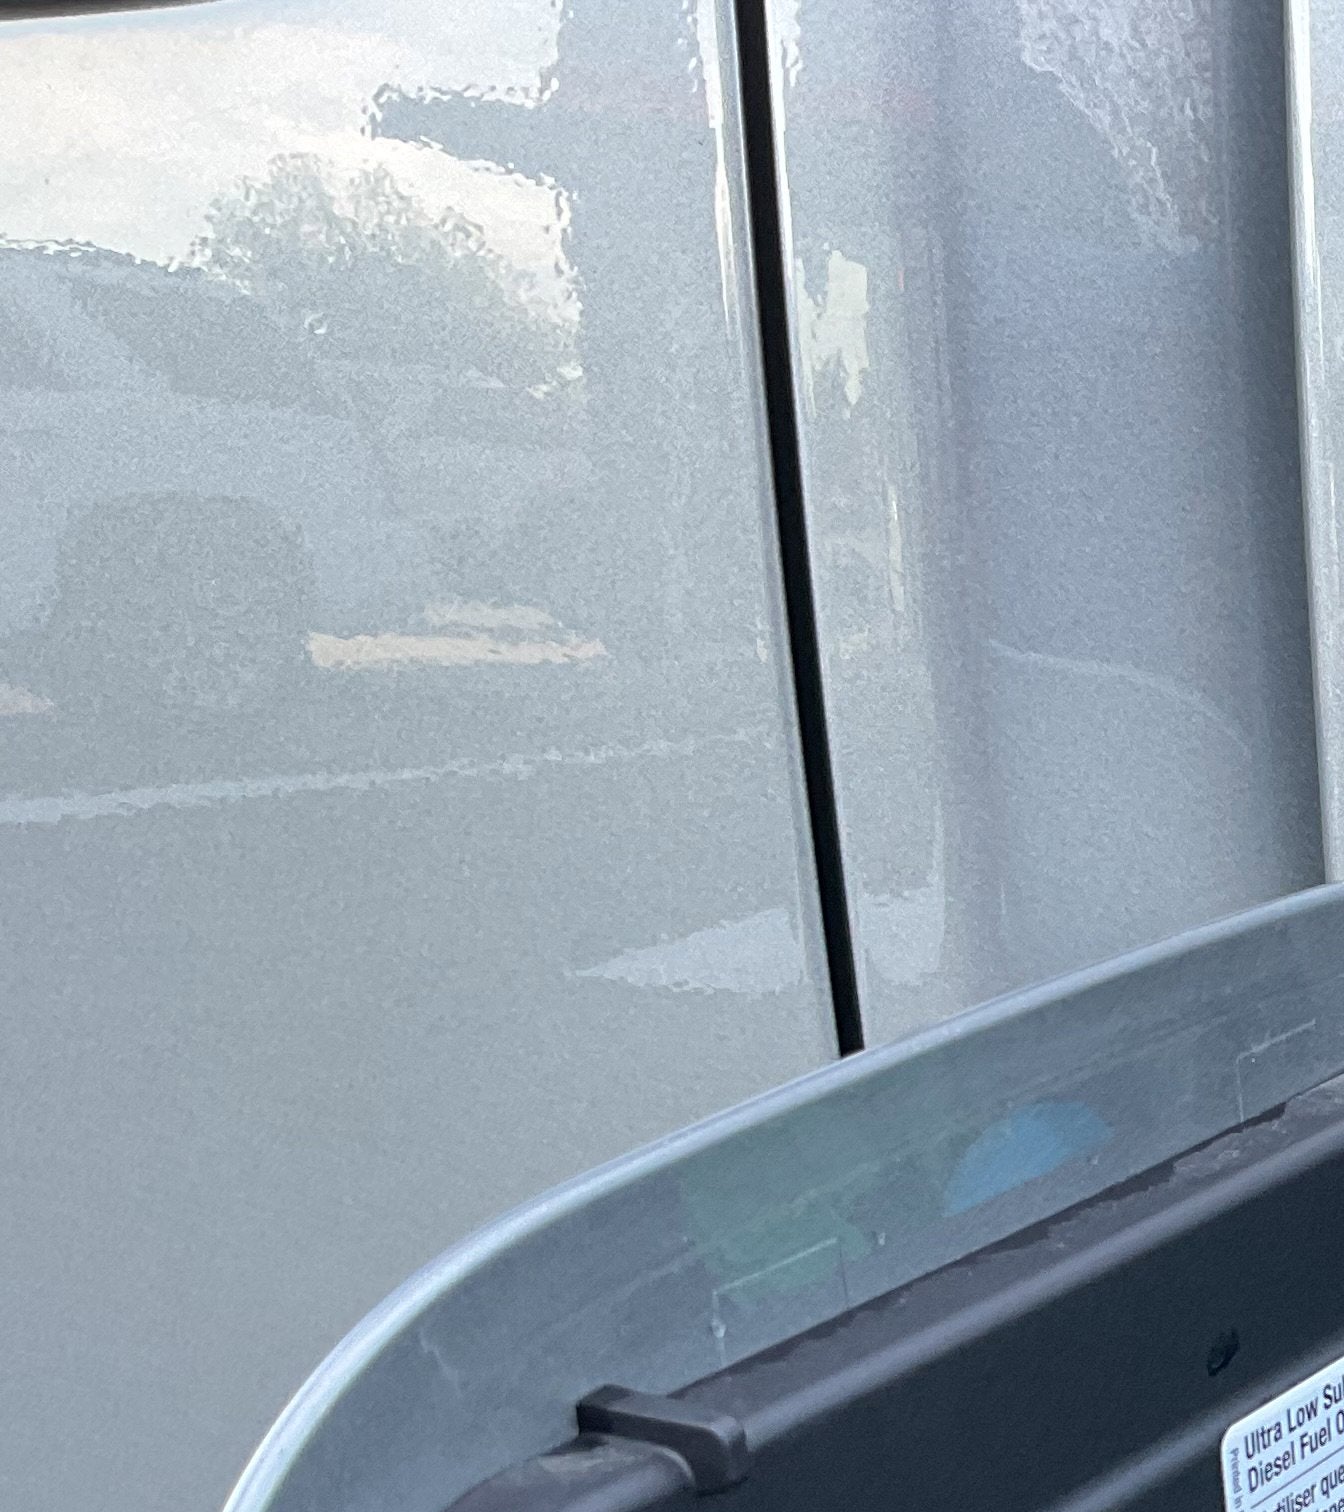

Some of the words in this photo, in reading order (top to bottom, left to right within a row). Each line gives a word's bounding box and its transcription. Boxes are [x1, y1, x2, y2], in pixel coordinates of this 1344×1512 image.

[1244, 1421, 1283, 1459] Ultra
[1287, 1397, 1319, 1434] Low
[1230, 1448, 1243, 1494] Printed
[1248, 1442, 1296, 1494] Diesel
[1300, 1418, 1332, 1460] Fuel
[1233, 1495, 1243, 1510] in
